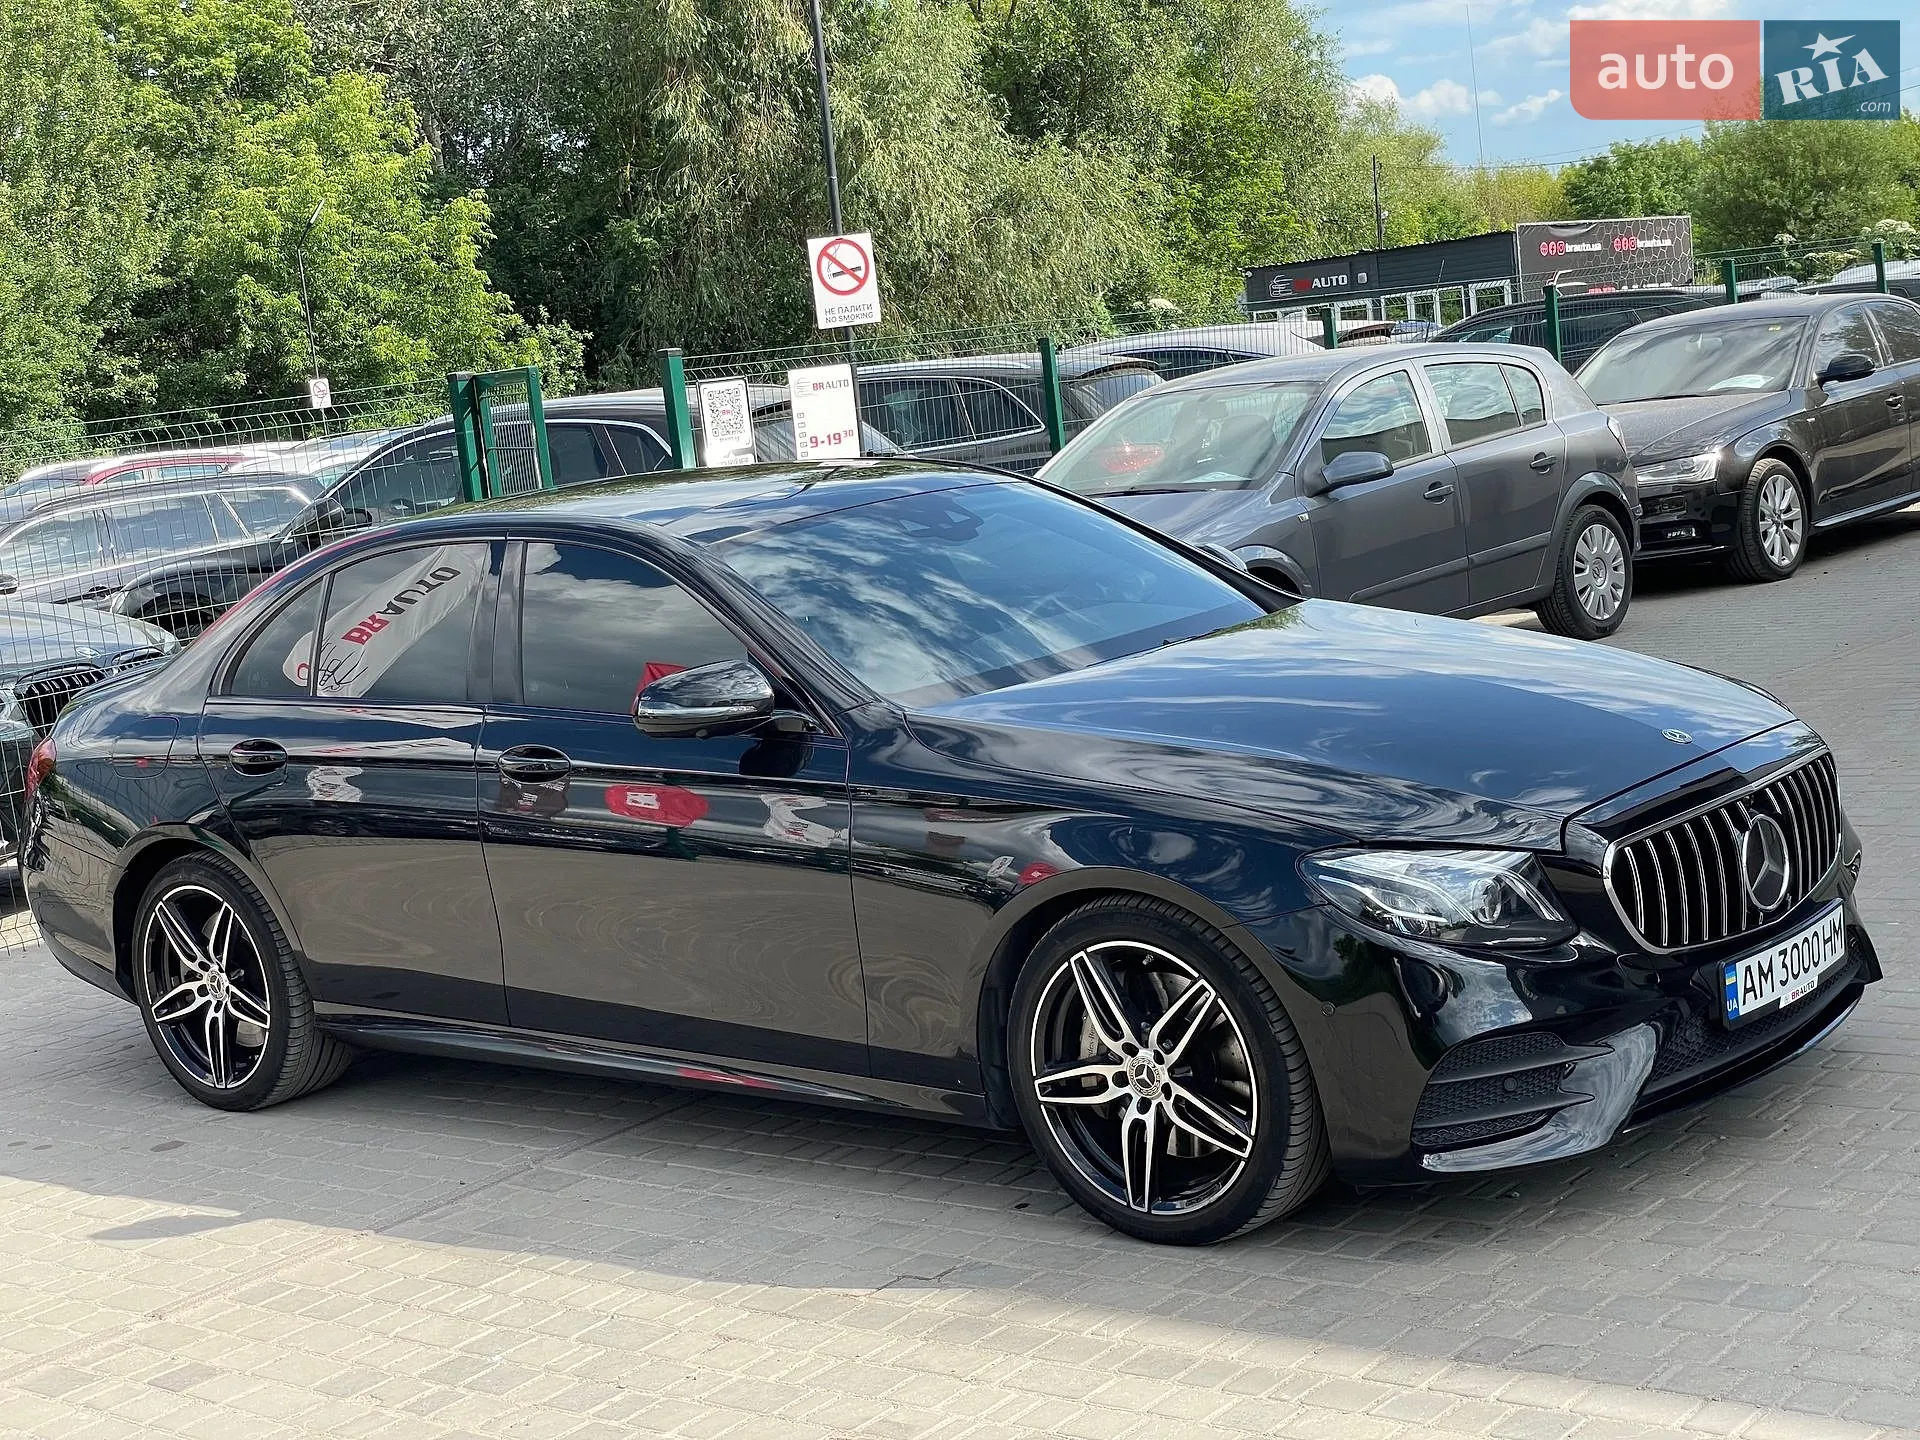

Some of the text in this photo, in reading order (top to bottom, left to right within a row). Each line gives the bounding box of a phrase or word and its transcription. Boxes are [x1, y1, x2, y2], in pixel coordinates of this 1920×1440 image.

[824, 303, 873, 316] НЕ ПАЛИТИ
[838, 311, 874, 321] SMOKING
[1742, 911, 1843, 1006] AM 3000 HM
[1791, 980, 1815, 1000] BRAUTO
[1726, 997, 1739, 1012] UA
